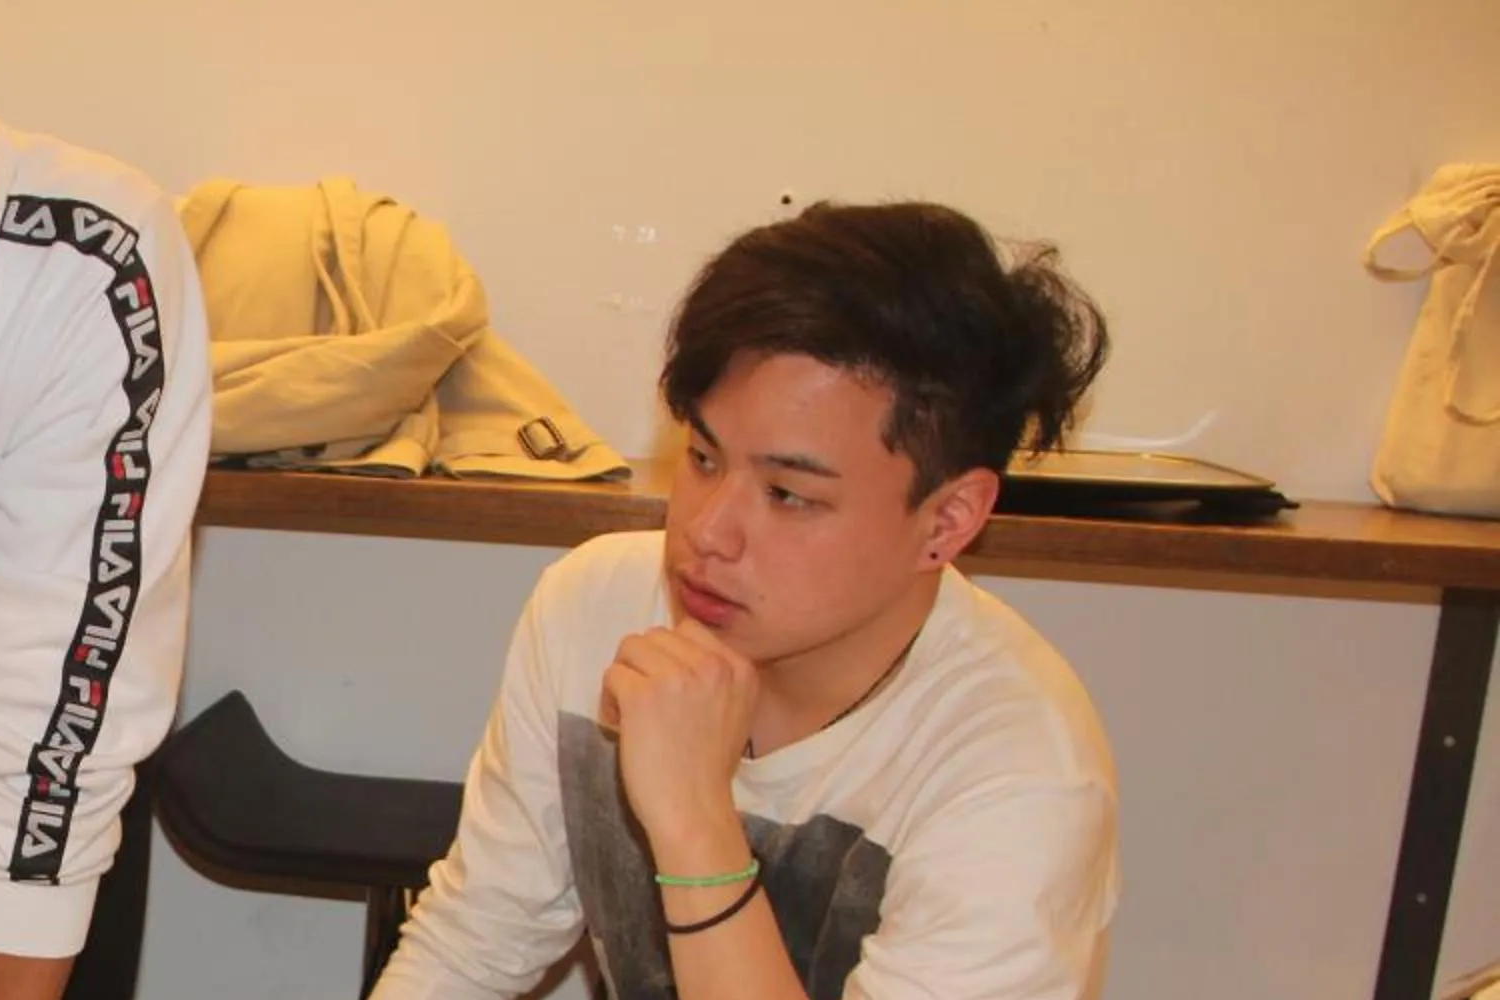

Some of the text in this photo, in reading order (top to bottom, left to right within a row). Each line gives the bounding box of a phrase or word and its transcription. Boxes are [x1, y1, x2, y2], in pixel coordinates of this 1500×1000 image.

[2, 201, 56, 239] LA
[72, 207, 135, 266] ILA
[115, 277, 160, 380] FILA
[112, 388, 163, 480] FILA
[97, 493, 142, 583] FILA
[73, 585, 131, 669] FILA
[48, 676, 103, 753] FILA
[21, 801, 65, 858] ILA
